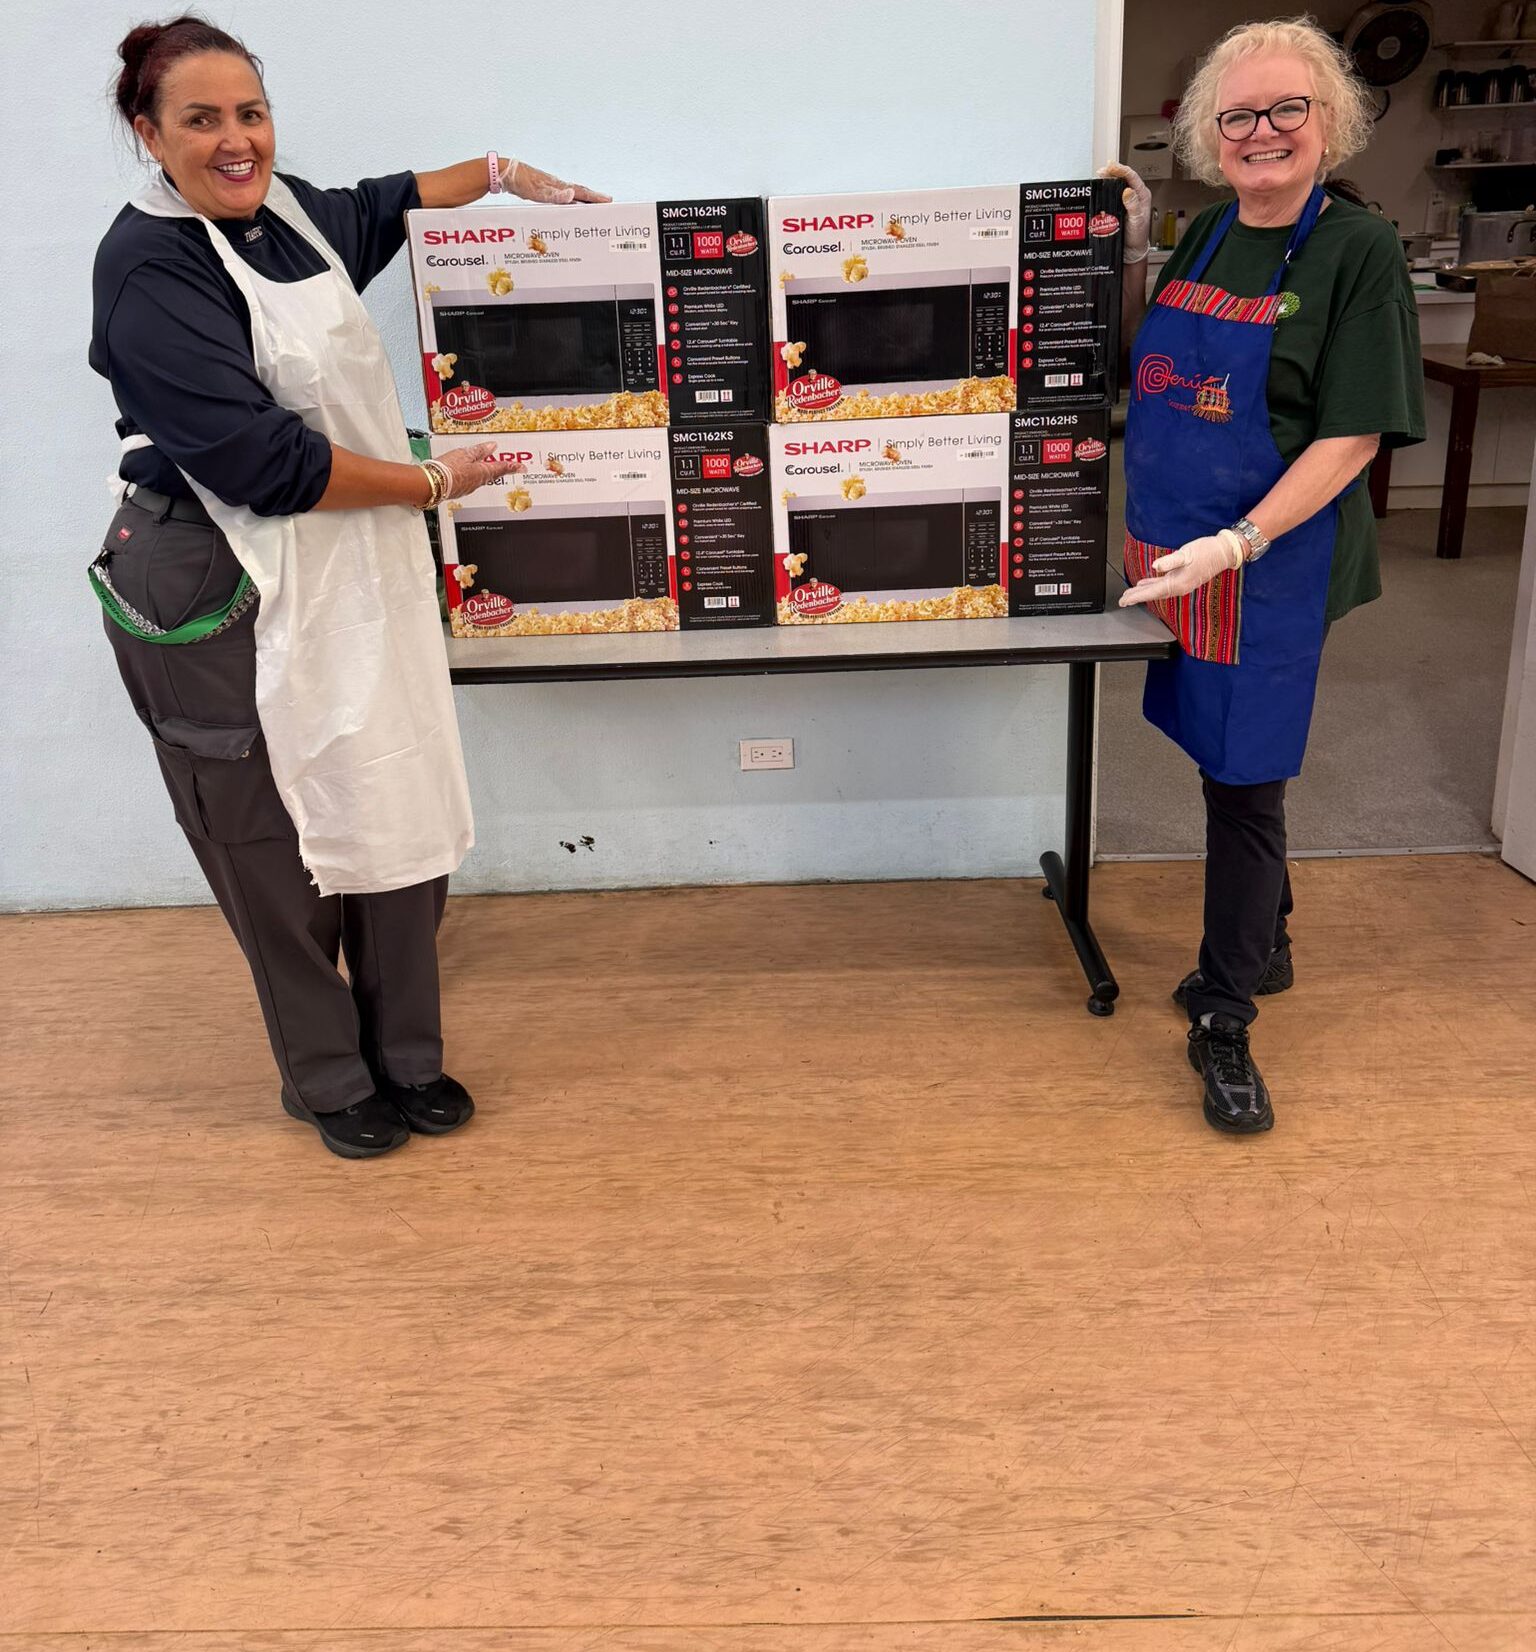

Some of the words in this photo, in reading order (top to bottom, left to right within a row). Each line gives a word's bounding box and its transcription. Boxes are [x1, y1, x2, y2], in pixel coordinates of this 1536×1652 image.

[1025, 187, 1092, 200] SMC1162HS
[662, 206, 727, 218] SMC1162HS
[889, 212, 930, 225] Simply
[934, 210, 971, 222] Better
[976, 208, 1012, 221] Living
[782, 214, 874, 233] SHARP
[1032, 219, 1044, 230] 1.1
[1058, 217, 1083, 228] 1000
[423, 228, 515, 245] SHARP
[530, 227, 570, 240] Simply
[574, 226, 611, 238] Better
[615, 226, 650, 238] Living
[671, 237, 683, 248] 1.1
[697, 236, 721, 247] 1000
[782, 241, 841, 255] Carousel
[1024, 251, 1051, 259] MID-SIZE
[1052, 249, 1093, 258] MICROWAVE
[426, 254, 485, 267] Carousel
[666, 269, 692, 277] MID-SIZE
[693, 267, 733, 276] MICROWAVE
[792, 377, 835, 396] Orville
[446, 389, 488, 407] Orville
[1014, 415, 1078, 428] SMC1162HS
[673, 431, 734, 443] SMC1162KS
[886, 439, 924, 450] Simply
[928, 436, 964, 447] Better
[967, 434, 1002, 446] Living
[784, 439, 871, 456] SHARP
[1021, 444, 1033, 454] 1.1
[1046, 442, 1070, 453] 1000
[484, 452, 533, 463] ARP
[547, 451, 585, 462] Simply
[589, 450, 624, 460] Better
[628, 449, 661, 460] Living
[681, 459, 693, 469] 1.1
[705, 458, 728, 468] 1000
[785, 463, 841, 475] Carousel
[1013, 473, 1039, 481] MID-SIZE
[1040, 471, 1080, 479] MICROWAVE
[676, 487, 701, 495] MID-SIZE
[702, 486, 740, 494] MICROWAVE
[794, 585, 835, 603] Orville
[100, 590, 129, 626] TRANSPORT
[466, 596, 507, 613] Orville
